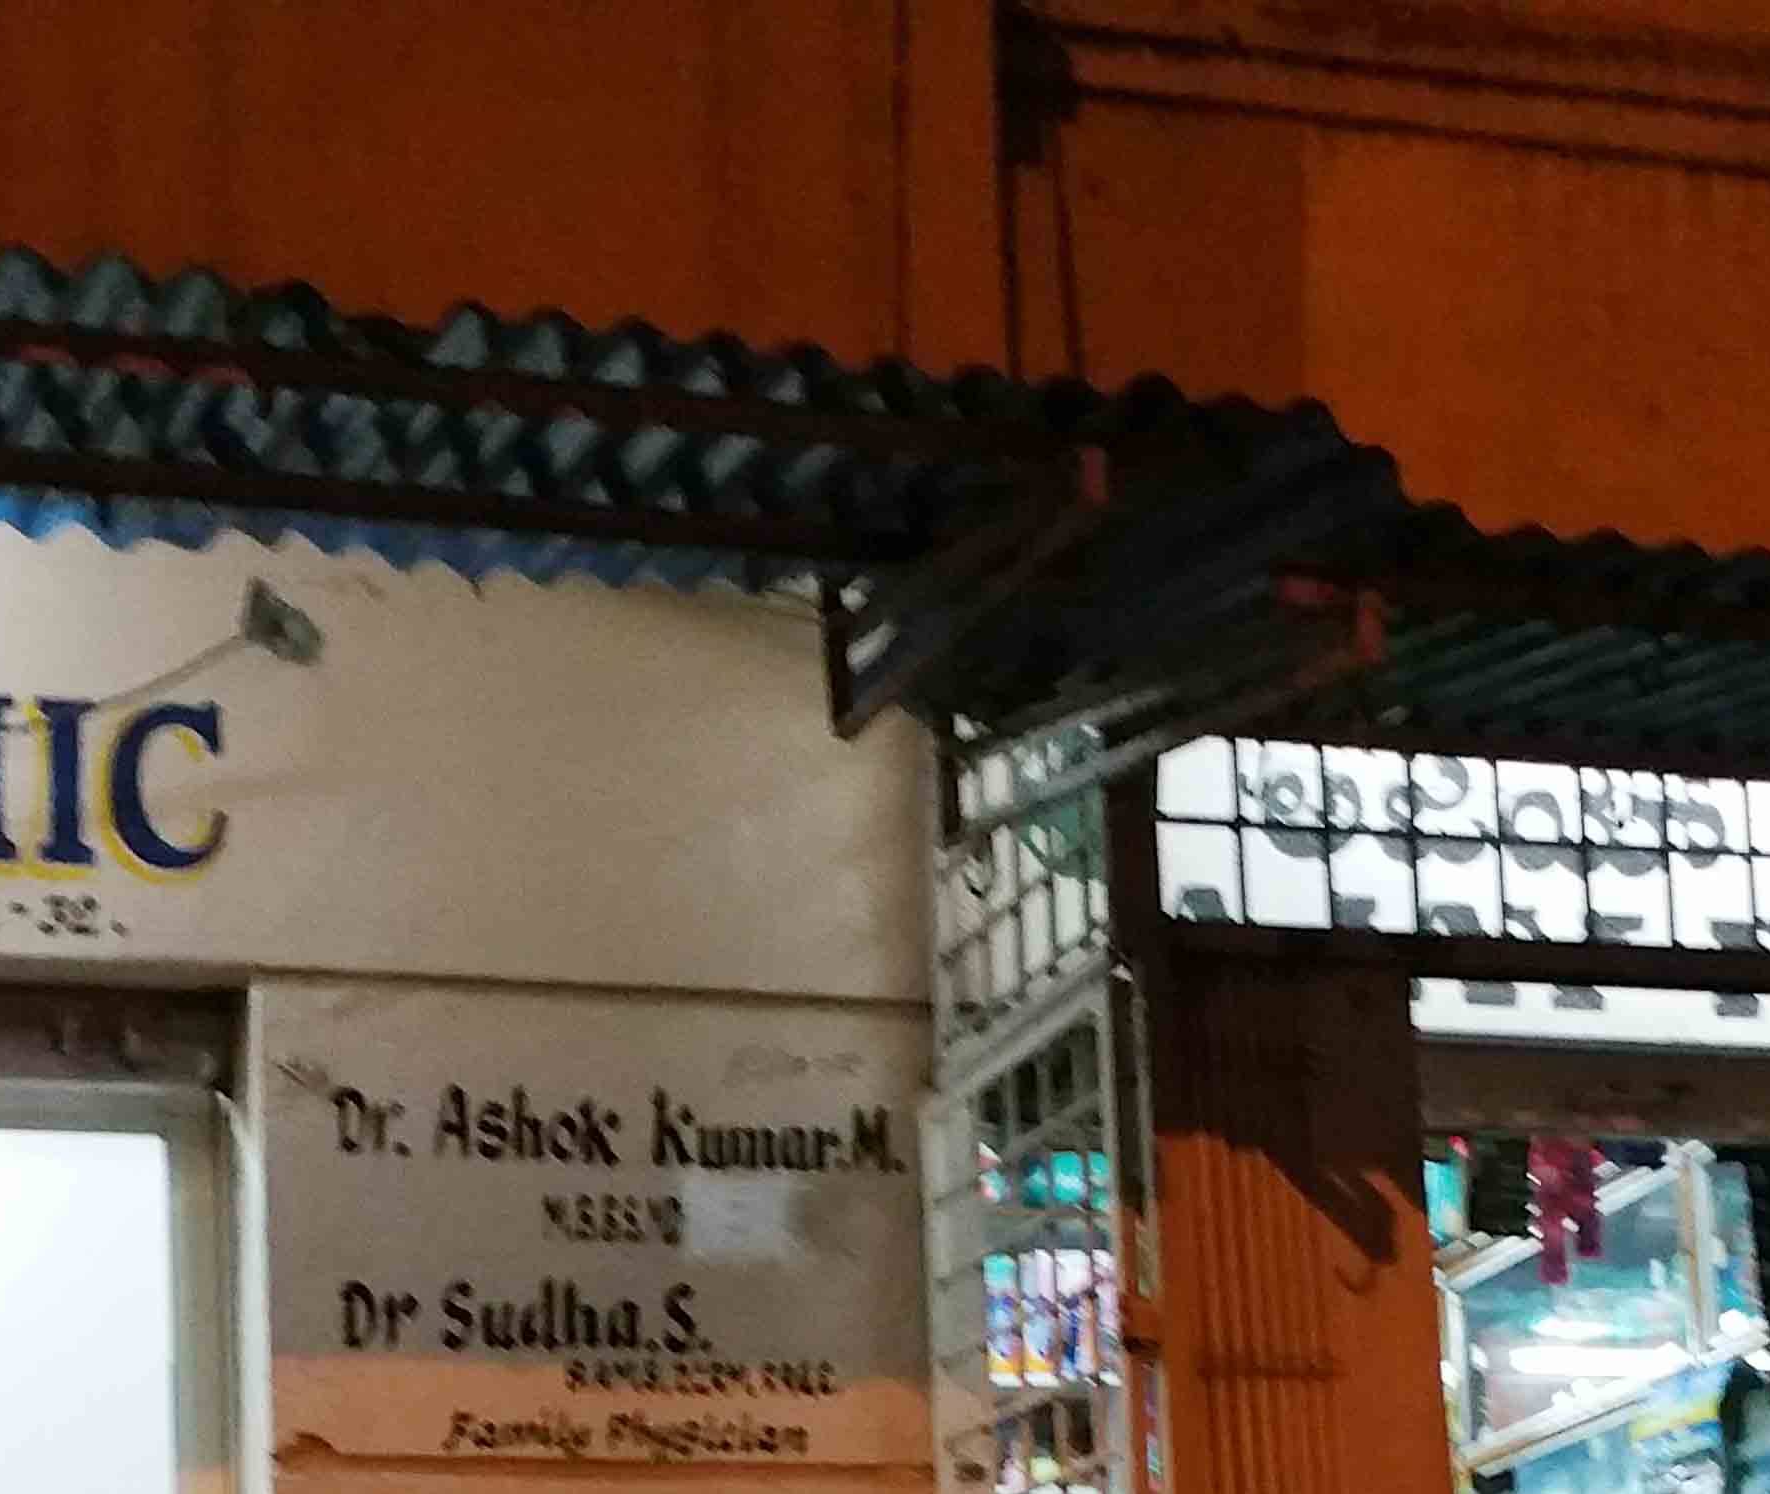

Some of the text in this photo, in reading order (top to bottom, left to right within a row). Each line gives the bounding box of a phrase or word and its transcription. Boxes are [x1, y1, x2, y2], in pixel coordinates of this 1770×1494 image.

[435, 1084, 622, 1167] Ashok
[441, 1407, 810, 1464] Family Physician
